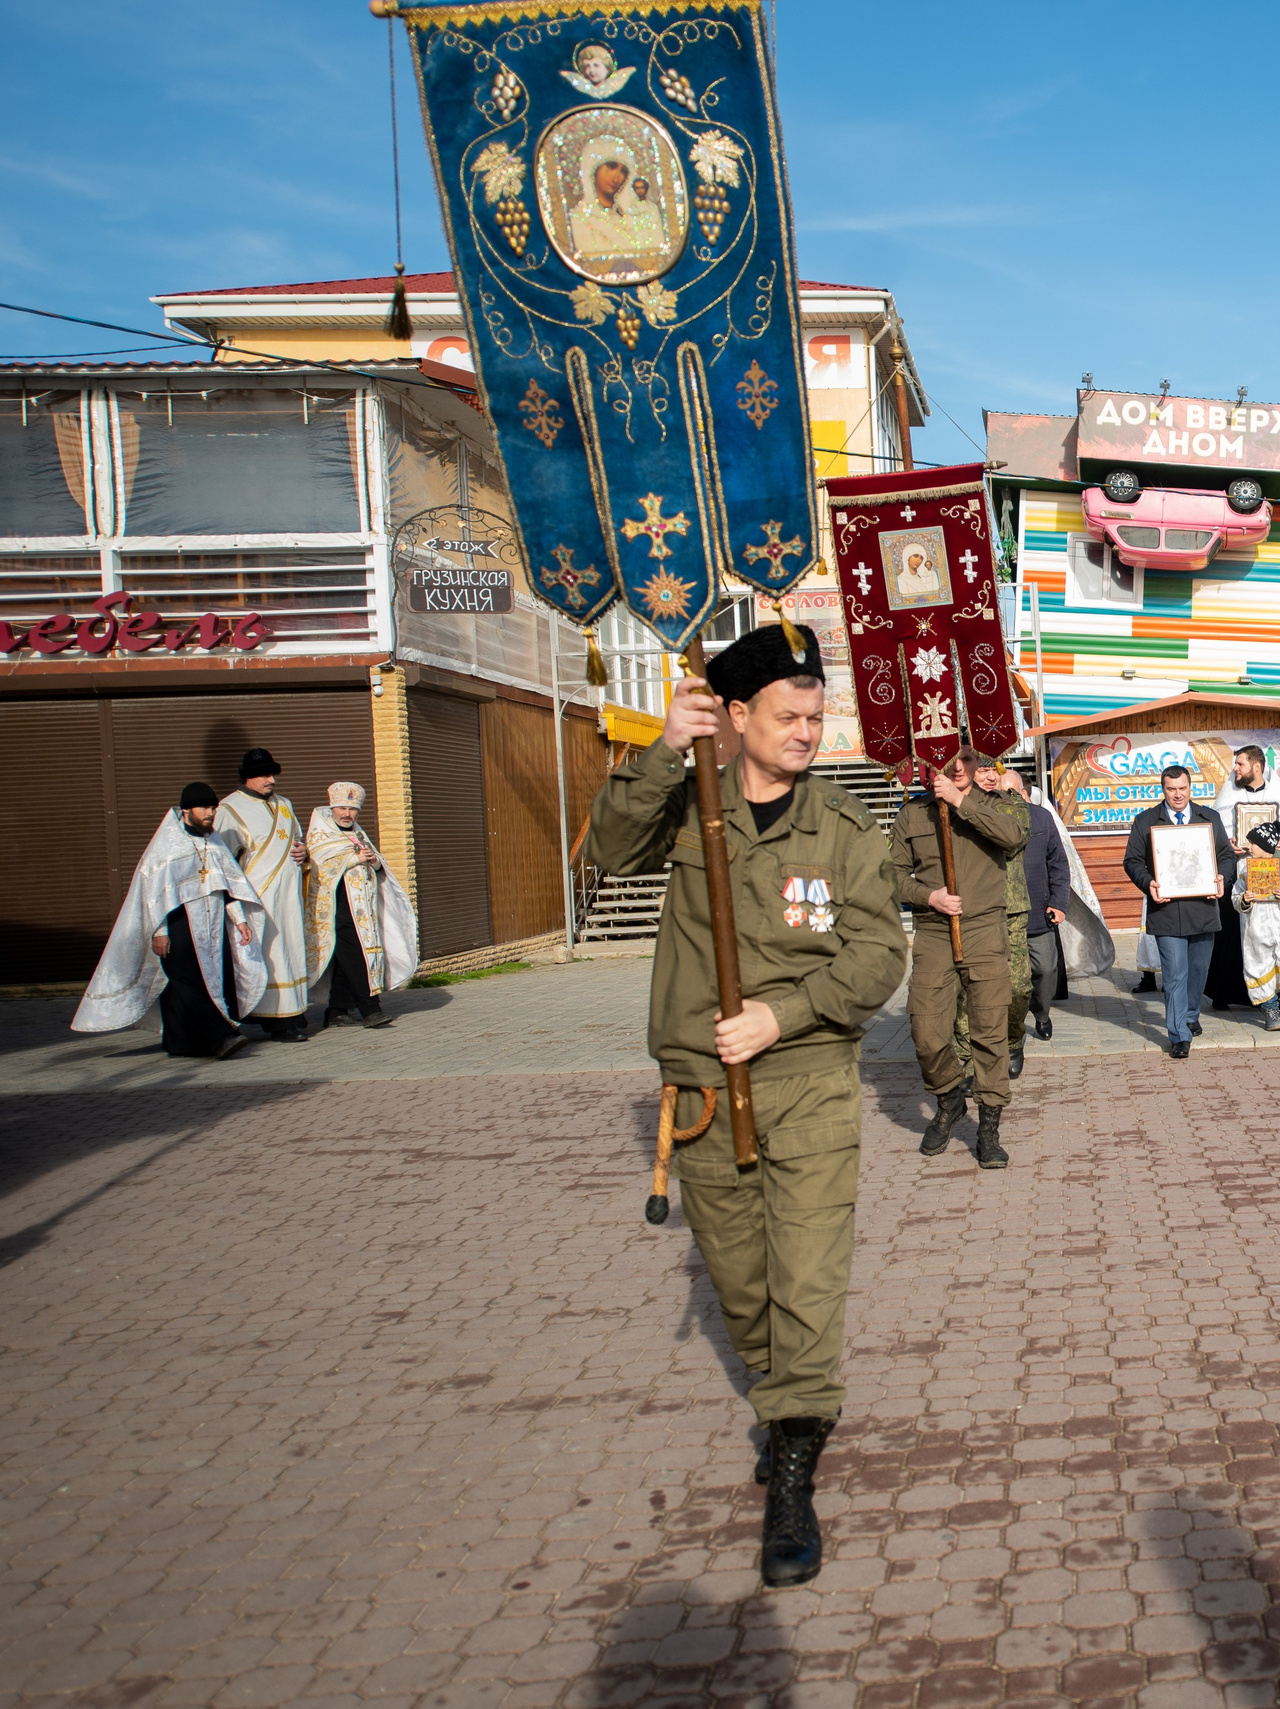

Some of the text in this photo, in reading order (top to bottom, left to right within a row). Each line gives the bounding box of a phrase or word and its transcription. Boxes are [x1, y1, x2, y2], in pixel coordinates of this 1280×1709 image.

[1096, 398, 1174, 427] ДОМ
[1142, 429, 1244, 459] ДНОМ
[430, 540, 485, 554] 2 этаж
[424, 588, 494, 612] КУХНЯ
[1077, 786, 1110, 802] МЫ
[1082, 806, 1146, 824] ЗИМН
